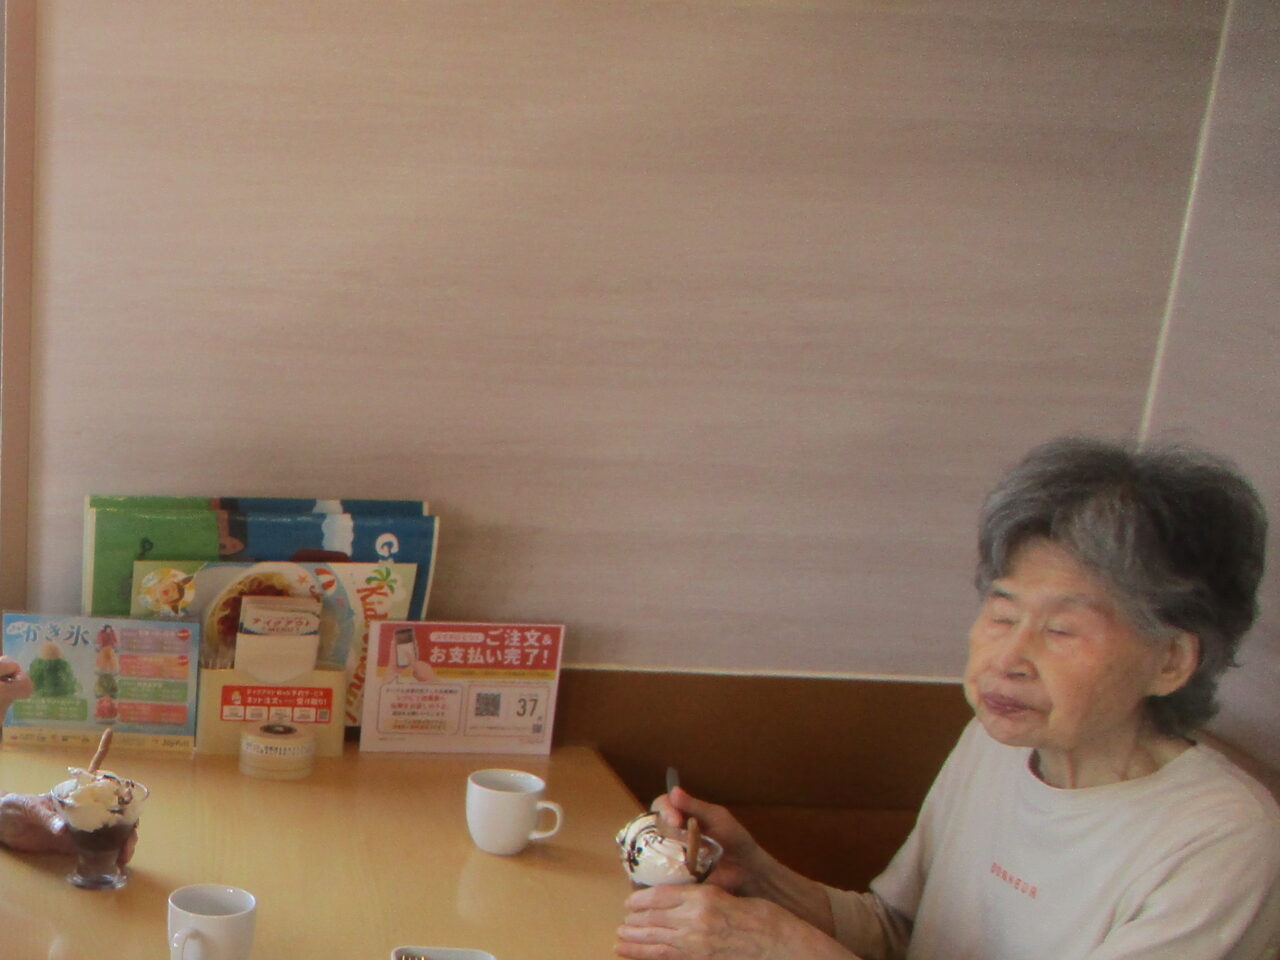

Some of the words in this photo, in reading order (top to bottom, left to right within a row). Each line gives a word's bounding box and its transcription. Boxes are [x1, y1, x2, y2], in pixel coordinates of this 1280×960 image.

[486, 627, 553, 648] ご注文&
[516, 697, 539, 718] 37
